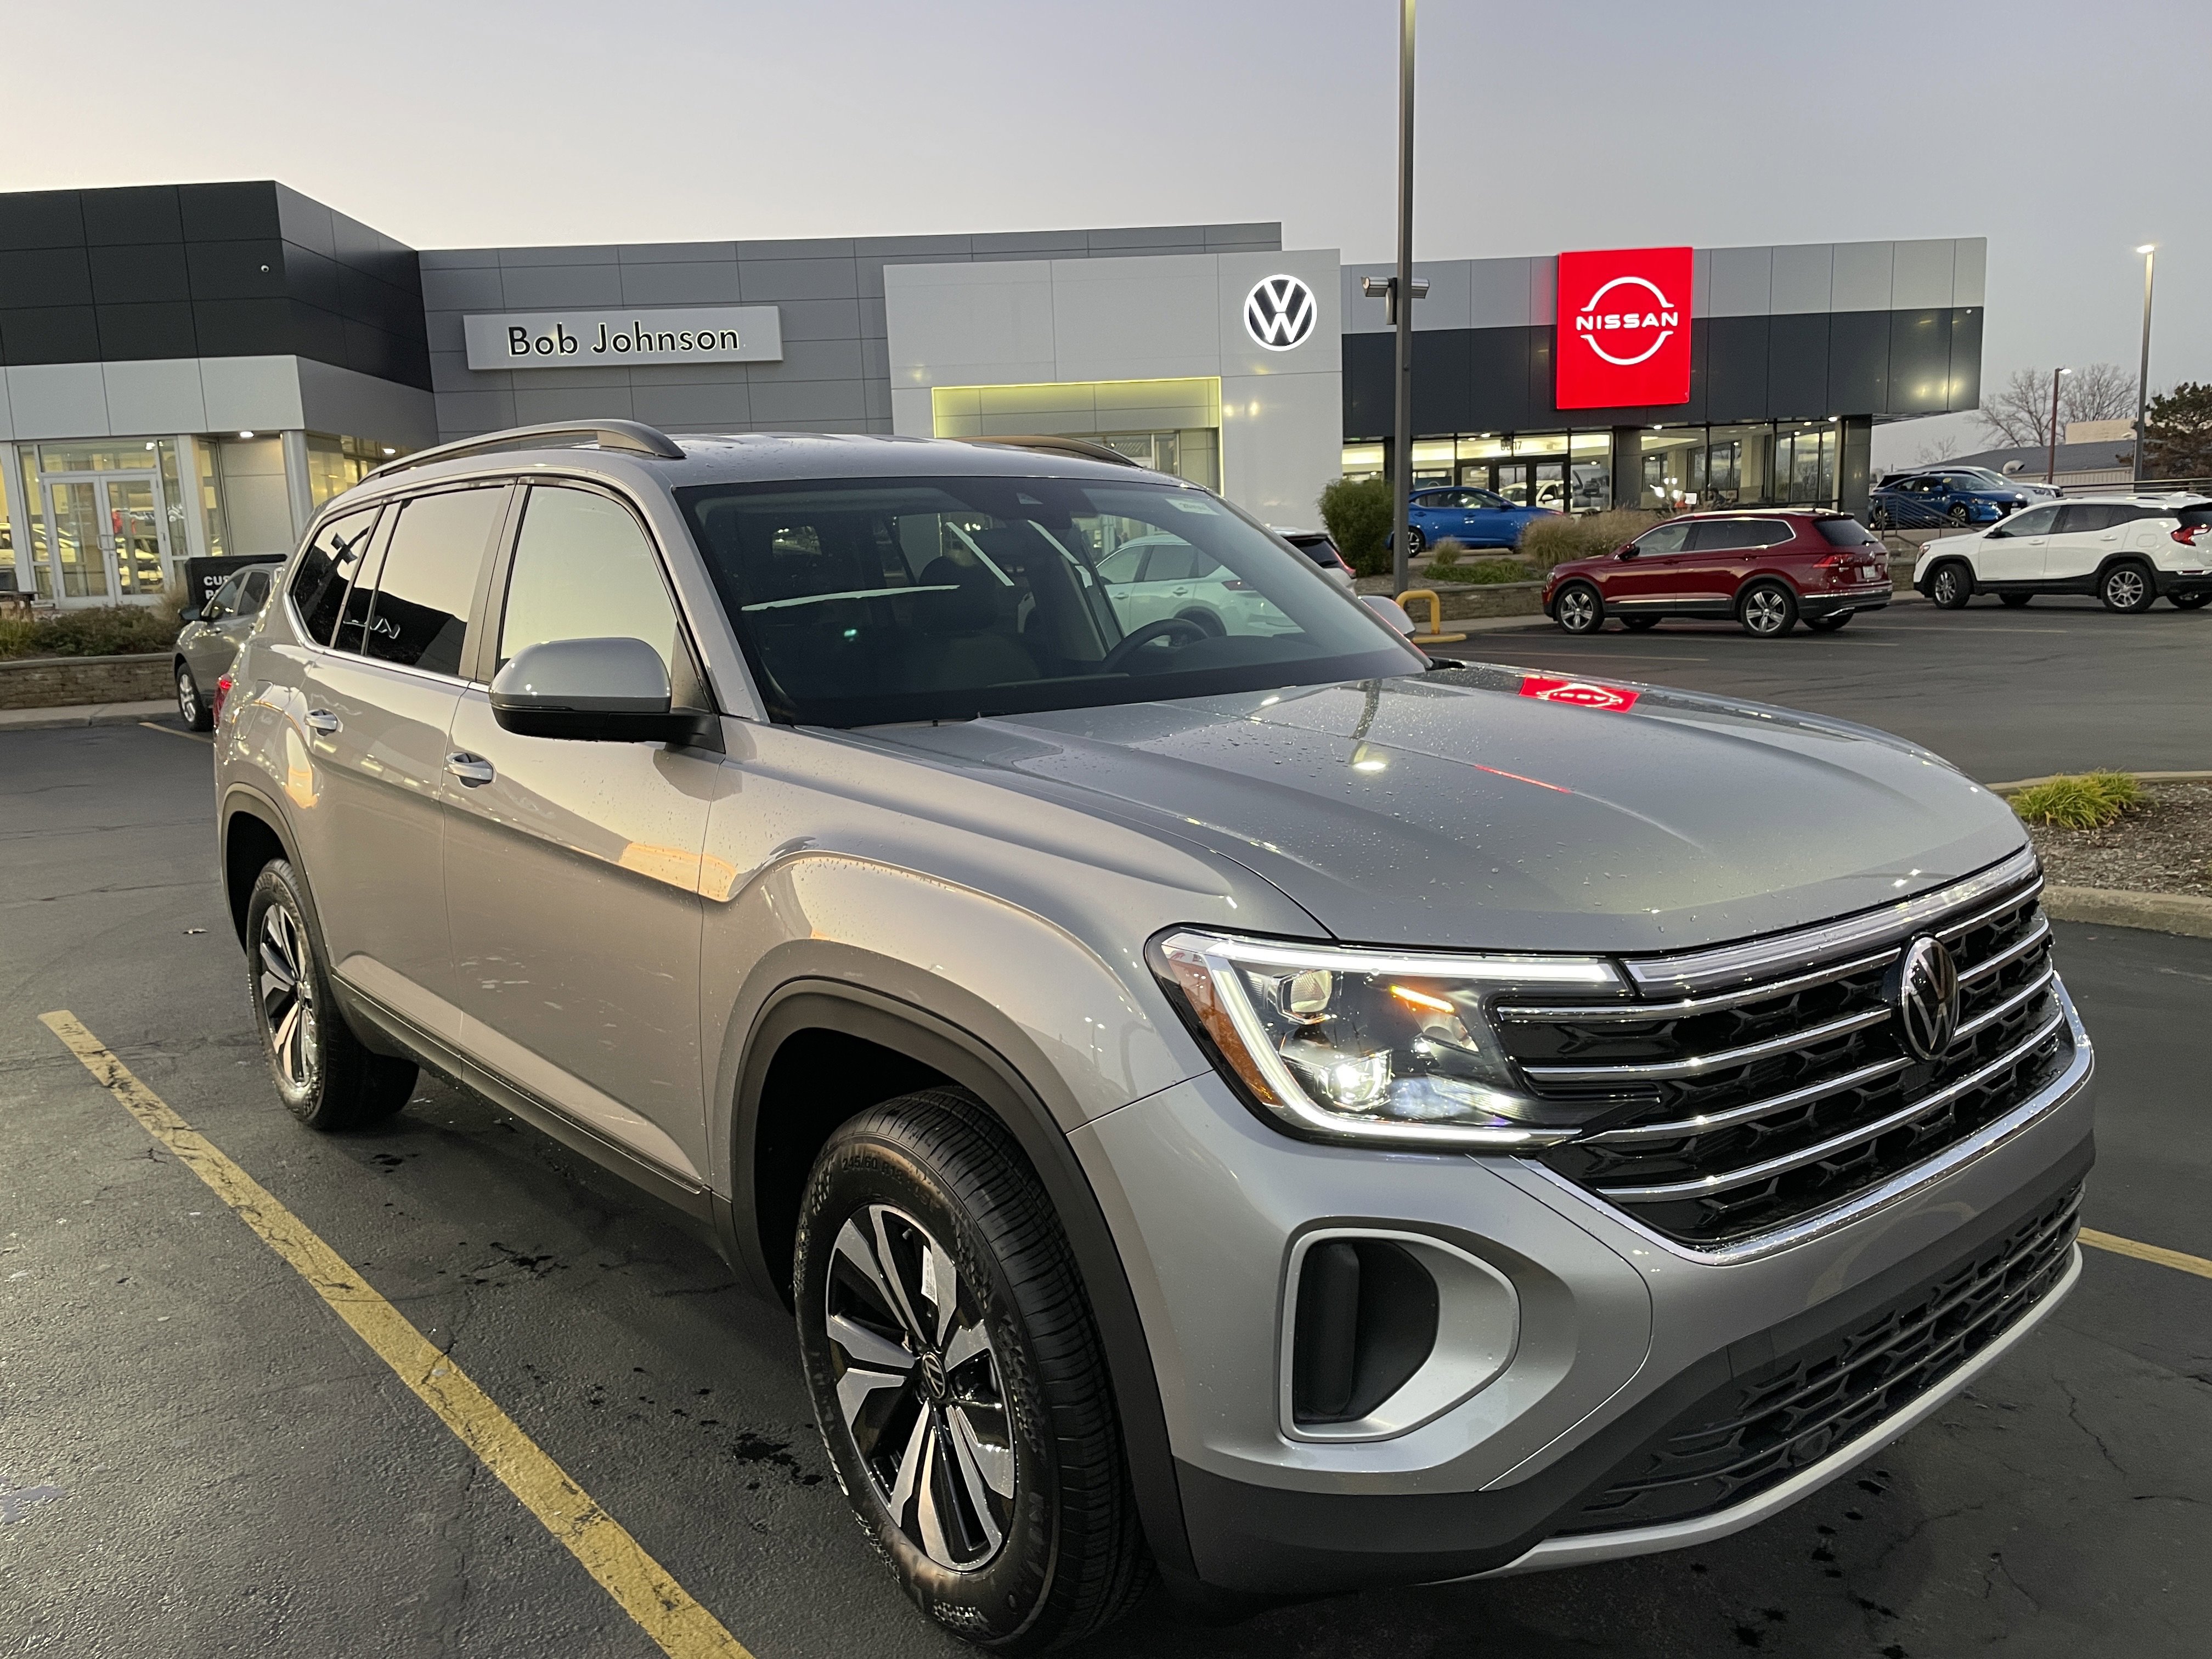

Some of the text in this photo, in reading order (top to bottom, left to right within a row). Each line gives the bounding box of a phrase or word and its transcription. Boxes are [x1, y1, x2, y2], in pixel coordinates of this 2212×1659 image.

[1576, 311, 1678, 331] NISSAN
[508, 320, 740, 357] Bob Johnson
